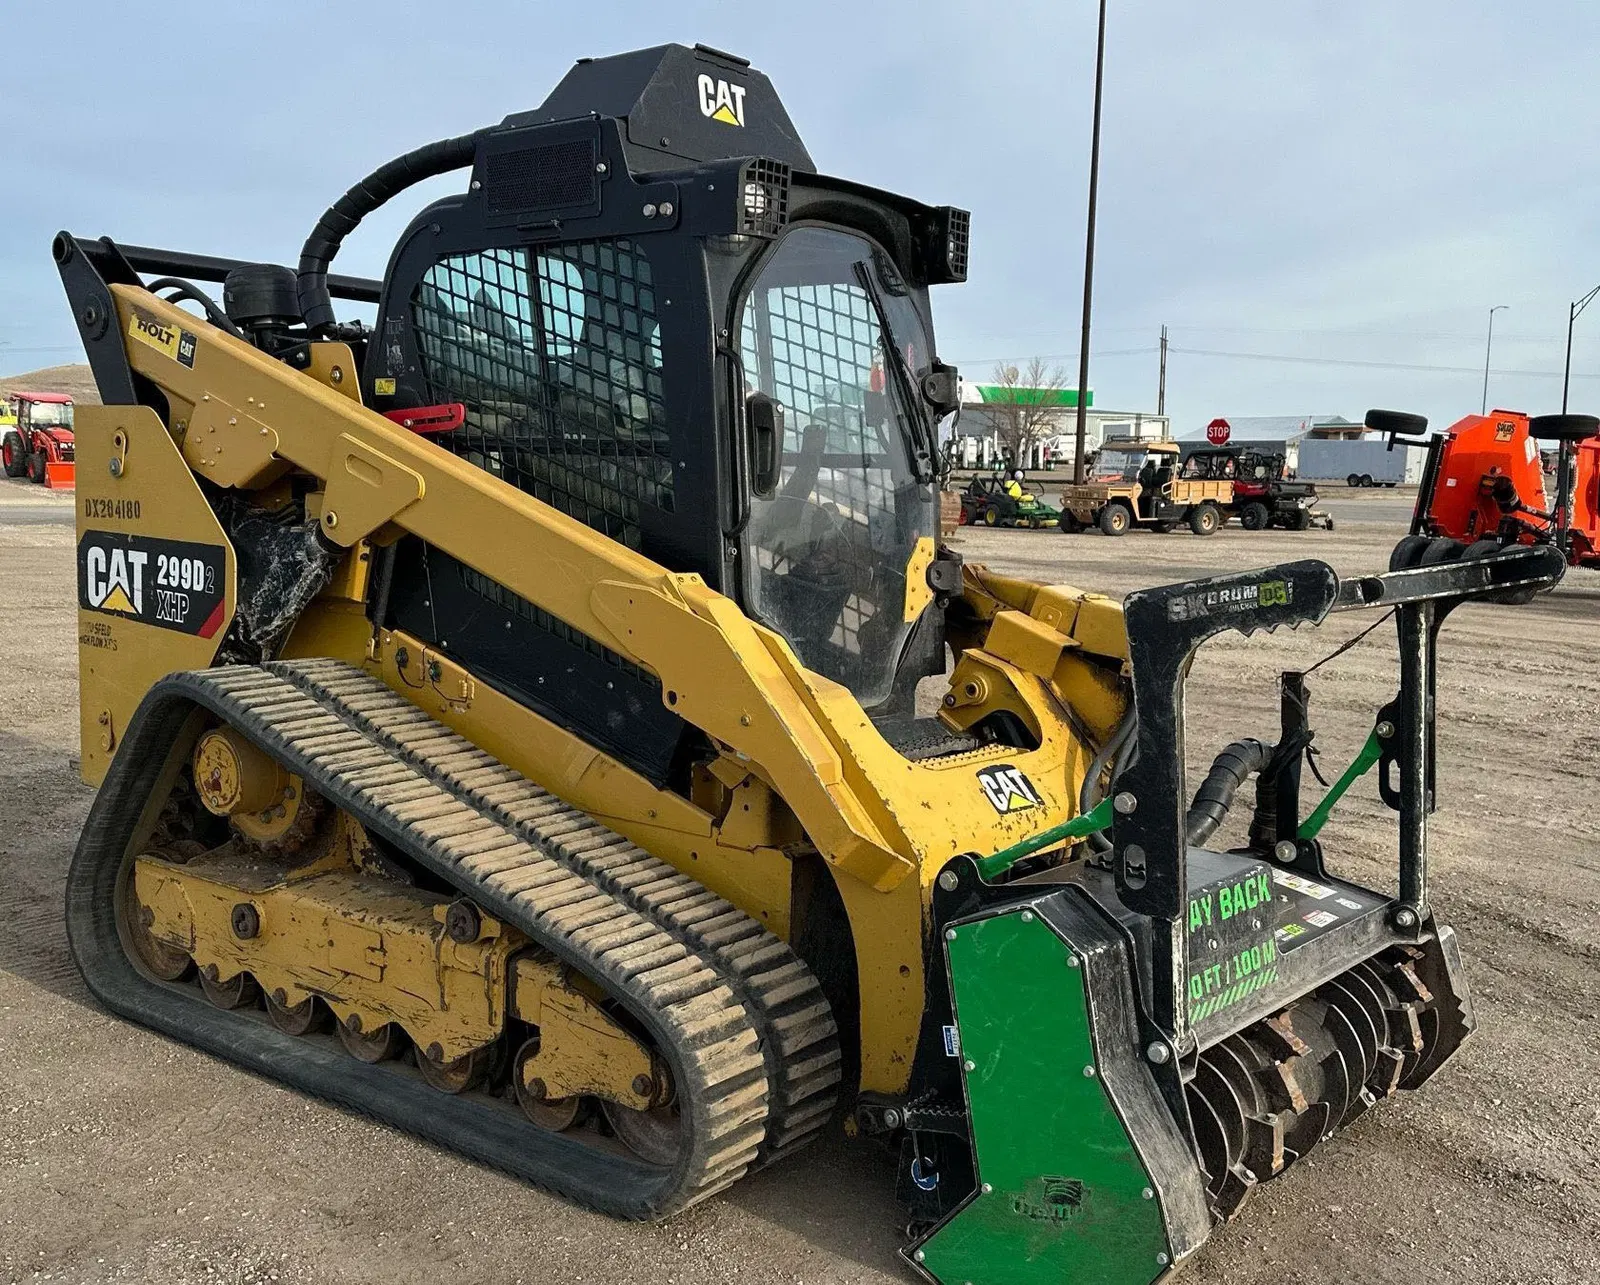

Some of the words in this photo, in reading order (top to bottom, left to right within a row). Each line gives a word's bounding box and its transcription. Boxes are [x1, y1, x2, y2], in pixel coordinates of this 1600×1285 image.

[698, 73, 746, 128] CAT
[137, 319, 175, 346] HOLT
[180, 340, 195, 358] CAT
[1208, 426, 1230, 438] STOP
[87, 546, 148, 615] CAT
[156, 588, 190, 623] XHP
[978, 768, 1038, 811] CAT
[1189, 893, 1212, 932] AY
[1219, 873, 1272, 921] BACK
[1204, 963, 1221, 993] FT
[1233, 945, 1261, 980] 100
[1263, 938, 1276, 965] M
